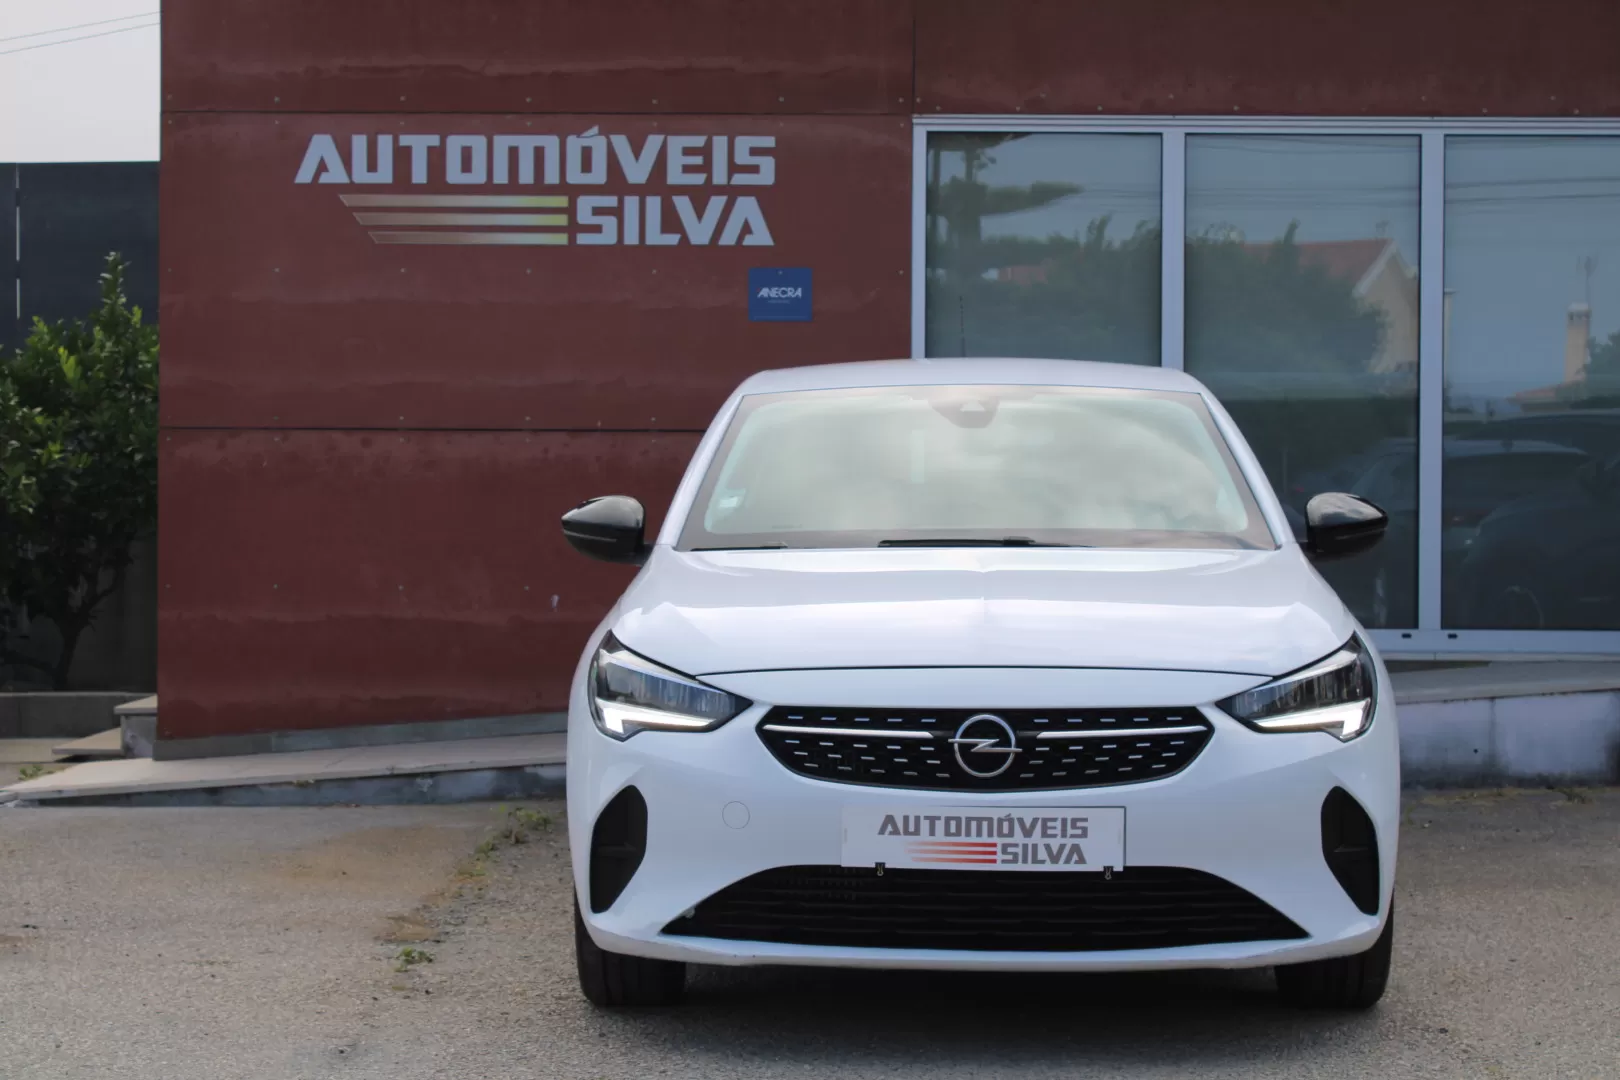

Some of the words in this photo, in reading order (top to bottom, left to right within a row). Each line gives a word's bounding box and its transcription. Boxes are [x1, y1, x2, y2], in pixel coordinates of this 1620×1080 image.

[294, 125, 776, 185] AUTOMÓVEIS
[576, 195, 775, 246] SILVA
[757, 287, 802, 298] ANECRA
[877, 813, 1089, 838] AUTOMÓVEIS
[1001, 843, 1087, 865] SILVA
